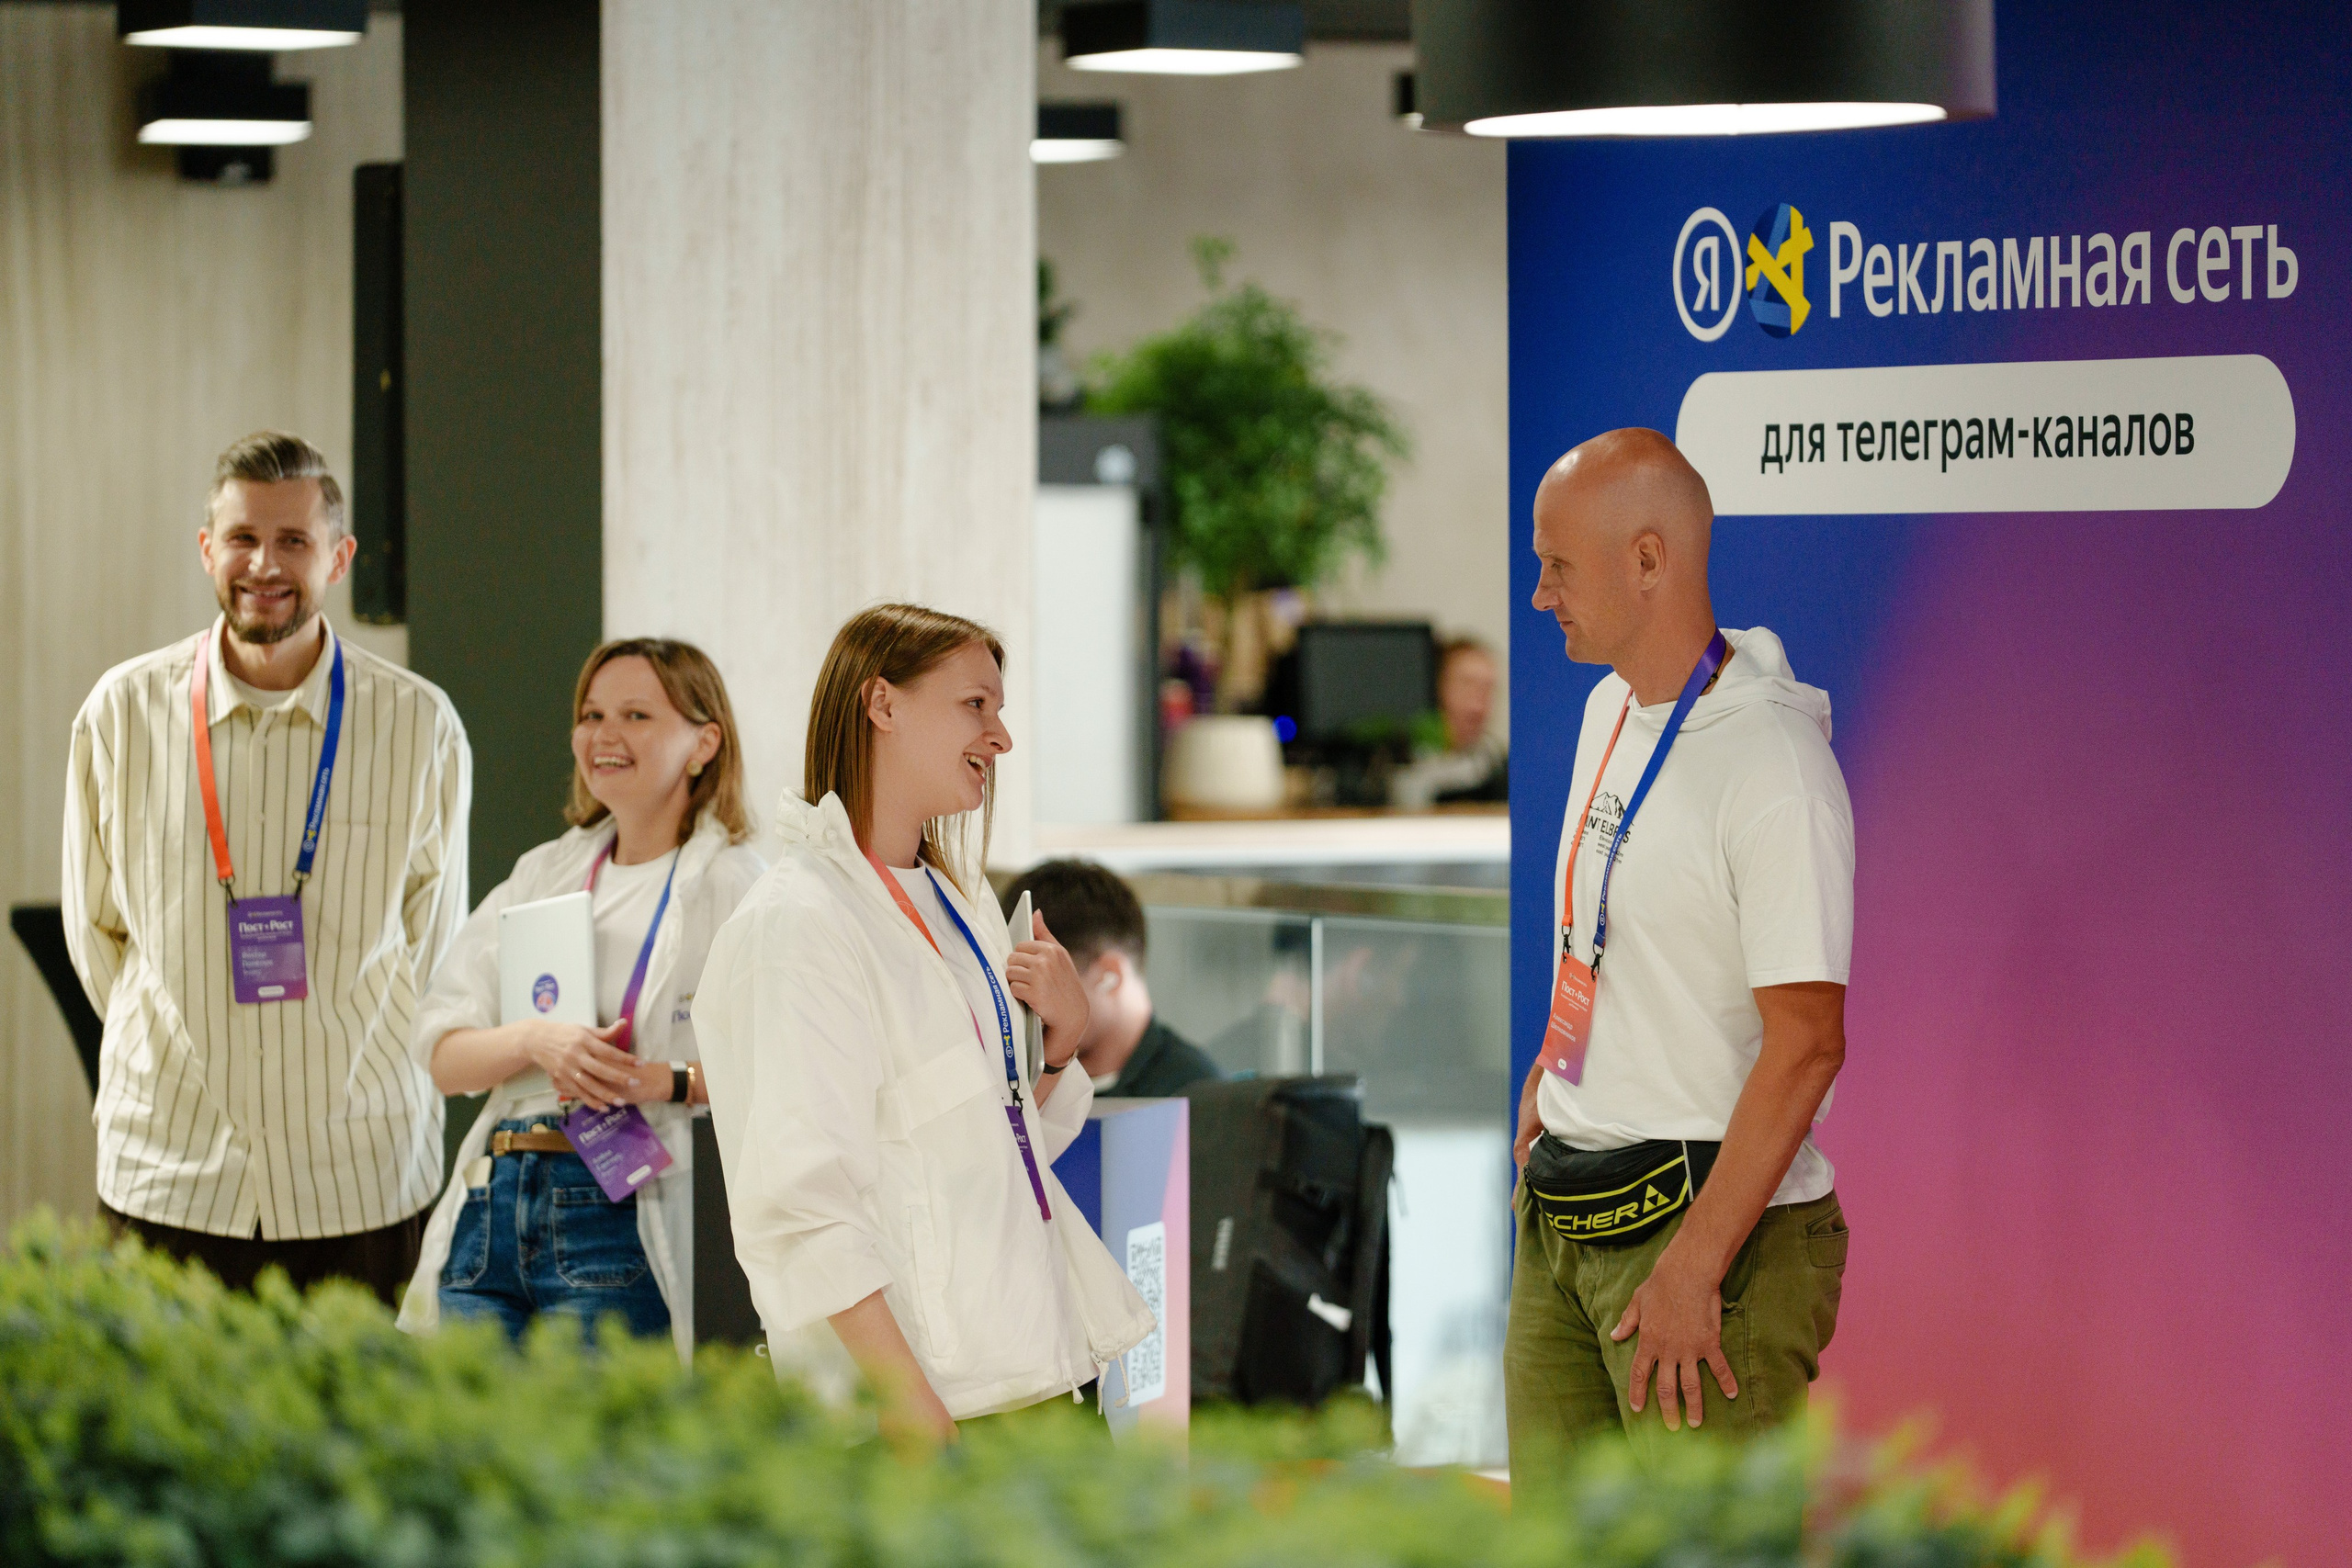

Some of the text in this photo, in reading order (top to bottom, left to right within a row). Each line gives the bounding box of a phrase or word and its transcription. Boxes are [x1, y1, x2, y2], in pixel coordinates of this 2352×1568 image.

[1829, 220, 2153, 319] Рекламная
[2165, 223, 2299, 303] сеть
[1760, 412, 2195, 475] для телеграм-каналов
[1600, 819, 1631, 843] ELBRS
[239, 919, 293, 934] Пост Рост
[986, 966, 996, 984] сеть
[1562, 980, 1576, 997] Пост
[1577, 990, 1590, 1006] Рост
[993, 985, 1010, 1033] Рекламная
